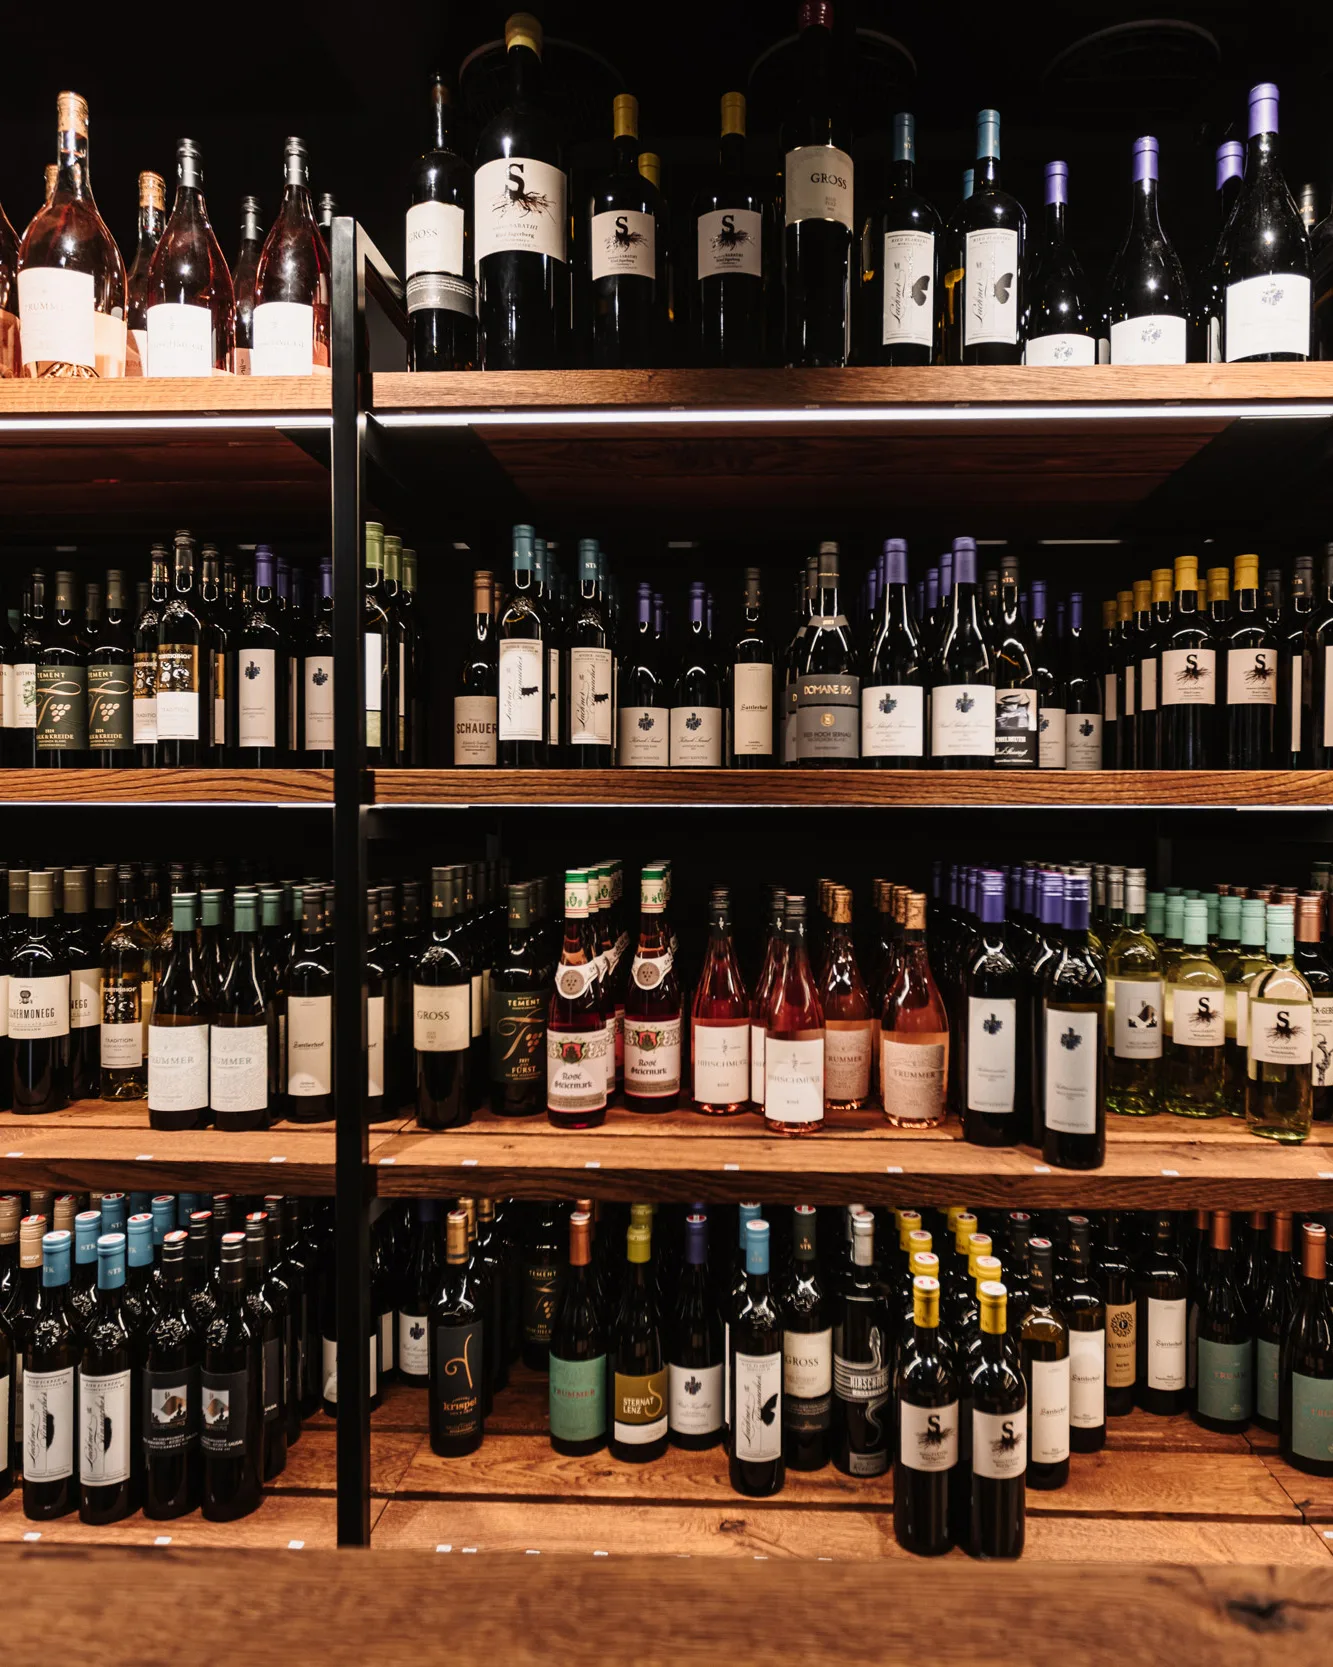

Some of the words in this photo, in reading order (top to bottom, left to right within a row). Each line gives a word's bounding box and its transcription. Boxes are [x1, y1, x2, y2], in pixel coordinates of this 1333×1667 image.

[810, 172, 848, 190] GROSS
[508, 998, 540, 1007] TEMENT
[416, 1010, 450, 1021] GROSS
[785, 1355, 819, 1368] GROSS
[623, 1396, 655, 1407] STERNAT
[623, 1406, 641, 1415] LENZ
